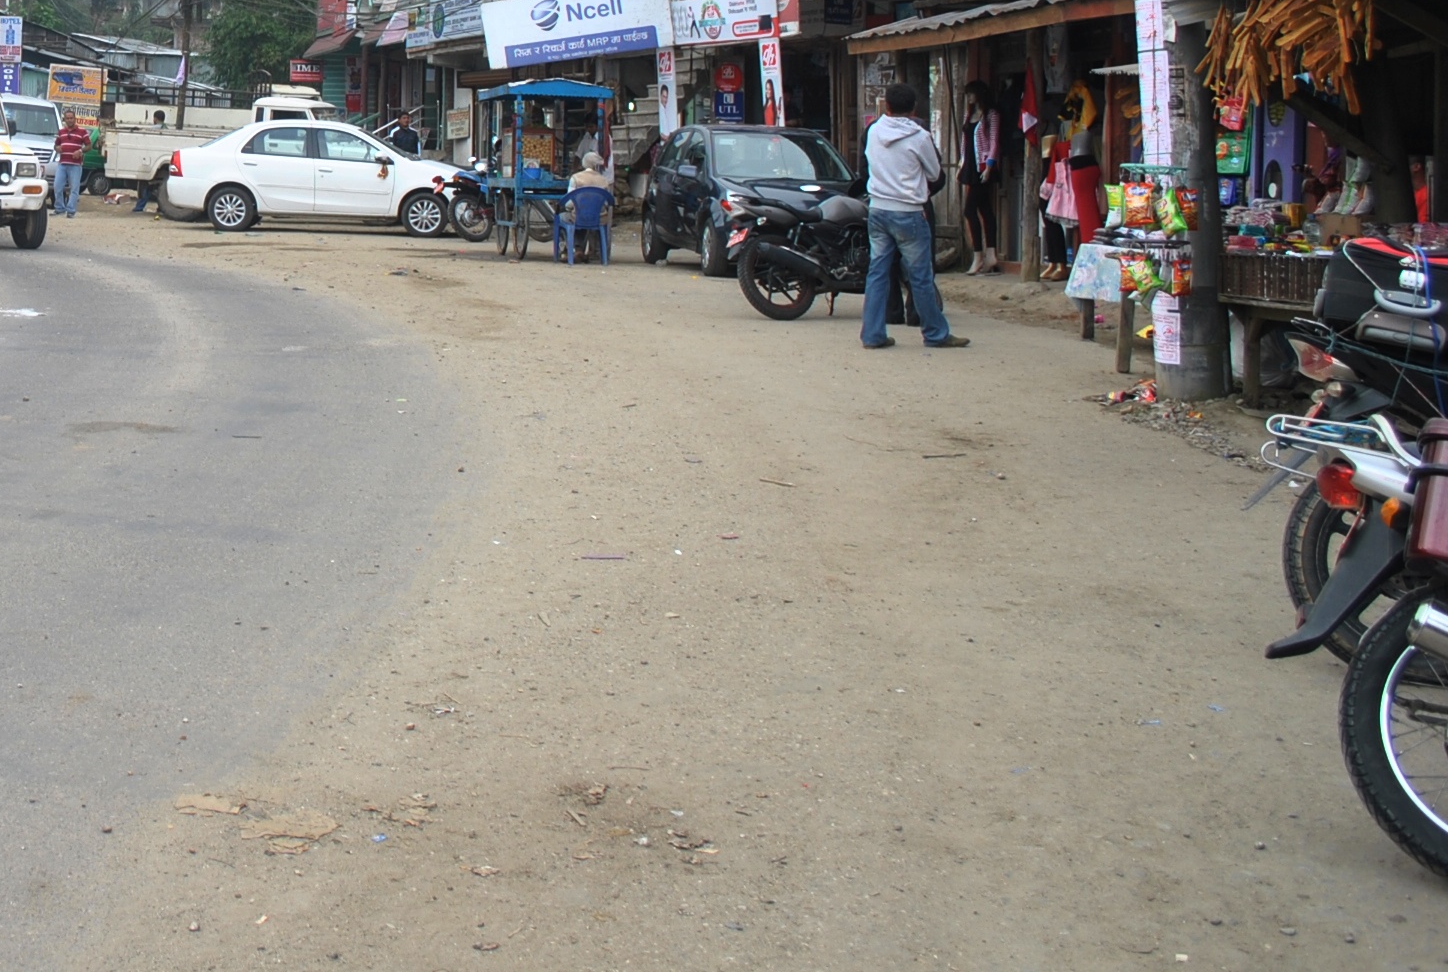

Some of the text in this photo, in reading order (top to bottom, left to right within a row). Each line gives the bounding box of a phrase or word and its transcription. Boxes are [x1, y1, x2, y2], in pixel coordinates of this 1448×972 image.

[0, 17, 22, 25] HOTEL
[587, 37, 610, 48] MRP
[718, 105, 739, 114] UTL
